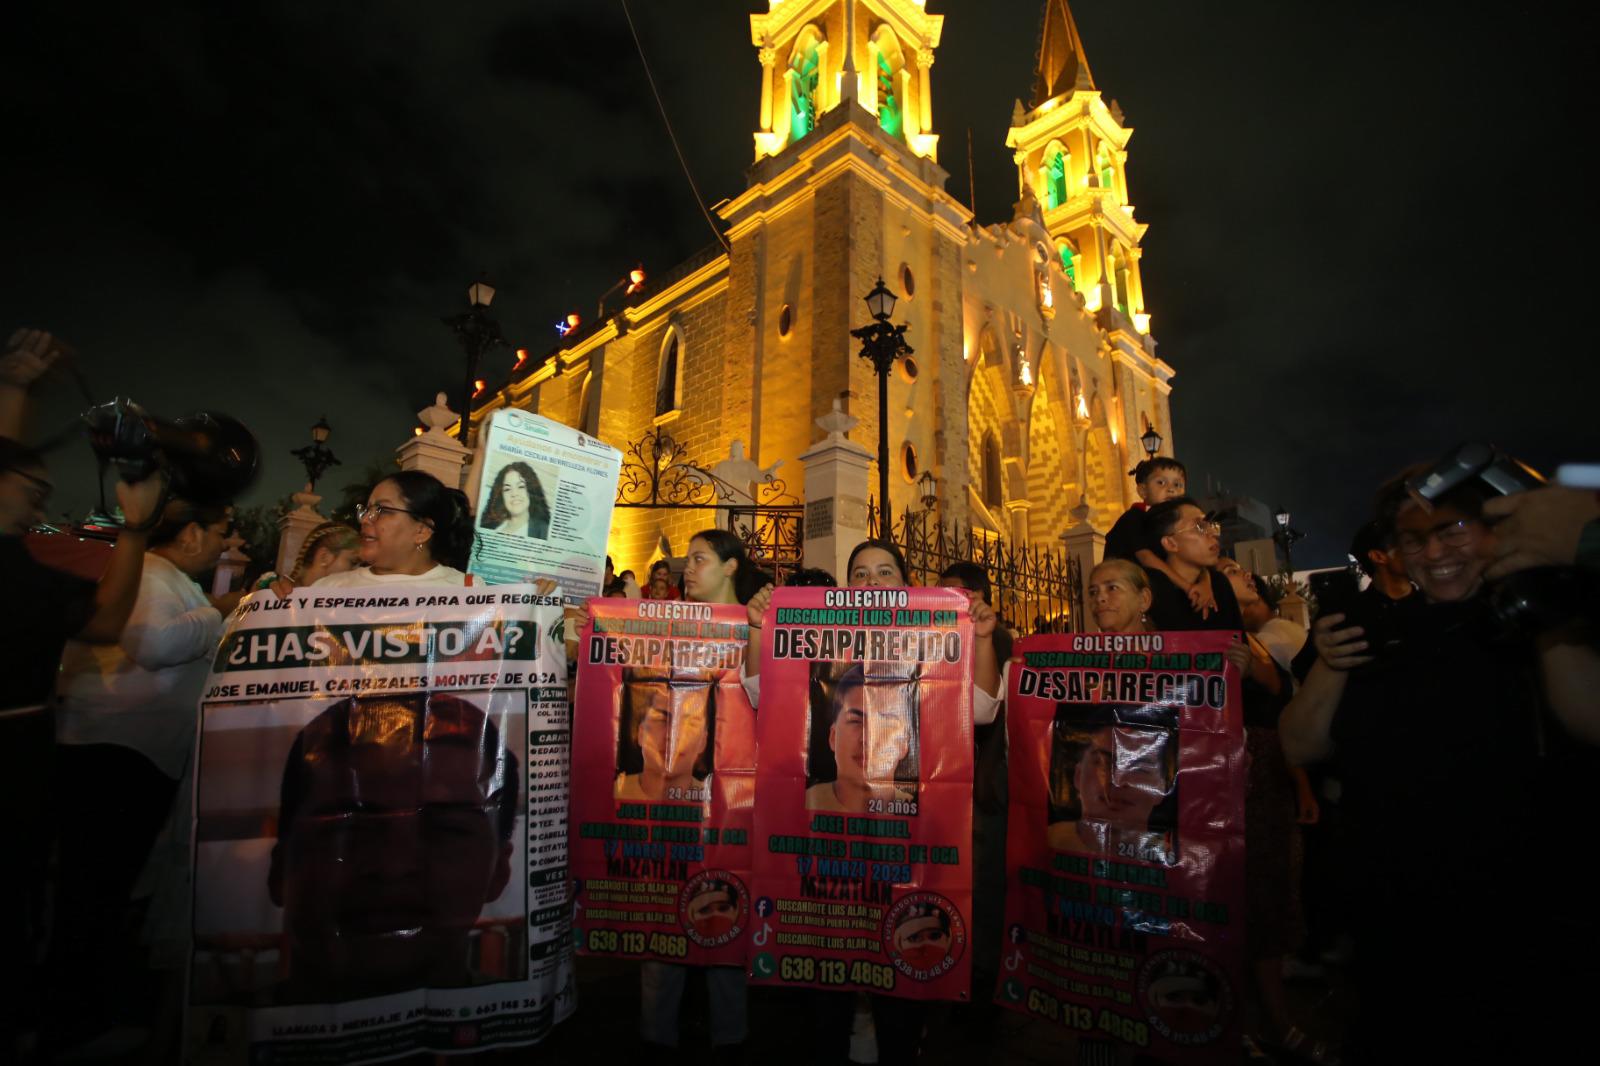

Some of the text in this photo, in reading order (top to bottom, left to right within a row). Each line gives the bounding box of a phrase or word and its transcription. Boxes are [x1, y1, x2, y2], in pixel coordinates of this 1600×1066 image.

[264, 598, 292, 611] LUZ
[298, 598, 308, 609] Y
[313, 596, 410, 609] ESPERANZA
[416, 595, 460, 606] PARA
[466, 594, 496, 606] QUE
[825, 590, 908, 608] COLECTIVO
[638, 603, 712, 621] COLECTIVO
[777, 608, 957, 627] BUSCANDOTE LUIS ALAN SM
[671, 622, 697, 638] LUIS
[229, 626, 524, 665] ¿HAS VISTO A?
[773, 628, 961, 664] DESAPARECIDO
[1073, 635, 1163, 651] COLECTIVO
[1114, 654, 1146, 669] LUIS
[1150, 654, 1190, 670] ALAN
[206, 672, 557, 698] JOSE EMANUEL CARRIZALES MONTES DE OCA
[1018, 668, 1226, 709] DESAPARECIDO
[668, 787, 683, 800] 24
[868, 799, 918, 815] 24 años
[811, 815, 910, 838] JOSE EMANUEL
[671, 844, 704, 862] 2025
[769, 836, 959, 864] CARRIZALES MONTES DE OCA
[1118, 842, 1135, 857] 24
[797, 857, 911, 882] 17 MARZO 2025
[630, 882, 646, 893] LUIS
[776, 899, 881, 920] BUSCANDOTE LUIS ALAN SM
[588, 929, 618, 953] 638
[621, 931, 646, 954] 113
[649, 932, 688, 958] 4868
[776, 932, 880, 953] BUSCANDOTE LUIS ALAN SM
[781, 956, 895, 990] 638 113 4868
[894, 955, 956, 981] 638 113 48 68
[272, 1023, 327, 1036] LLAMADA
[342, 1012, 401, 1030] MENSAJE
[476, 1003, 497, 1015] 663
[501, 999, 519, 1010] 148
[523, 999, 536, 1008] 36
[1027, 986, 1150, 1048] 638 113 4868
